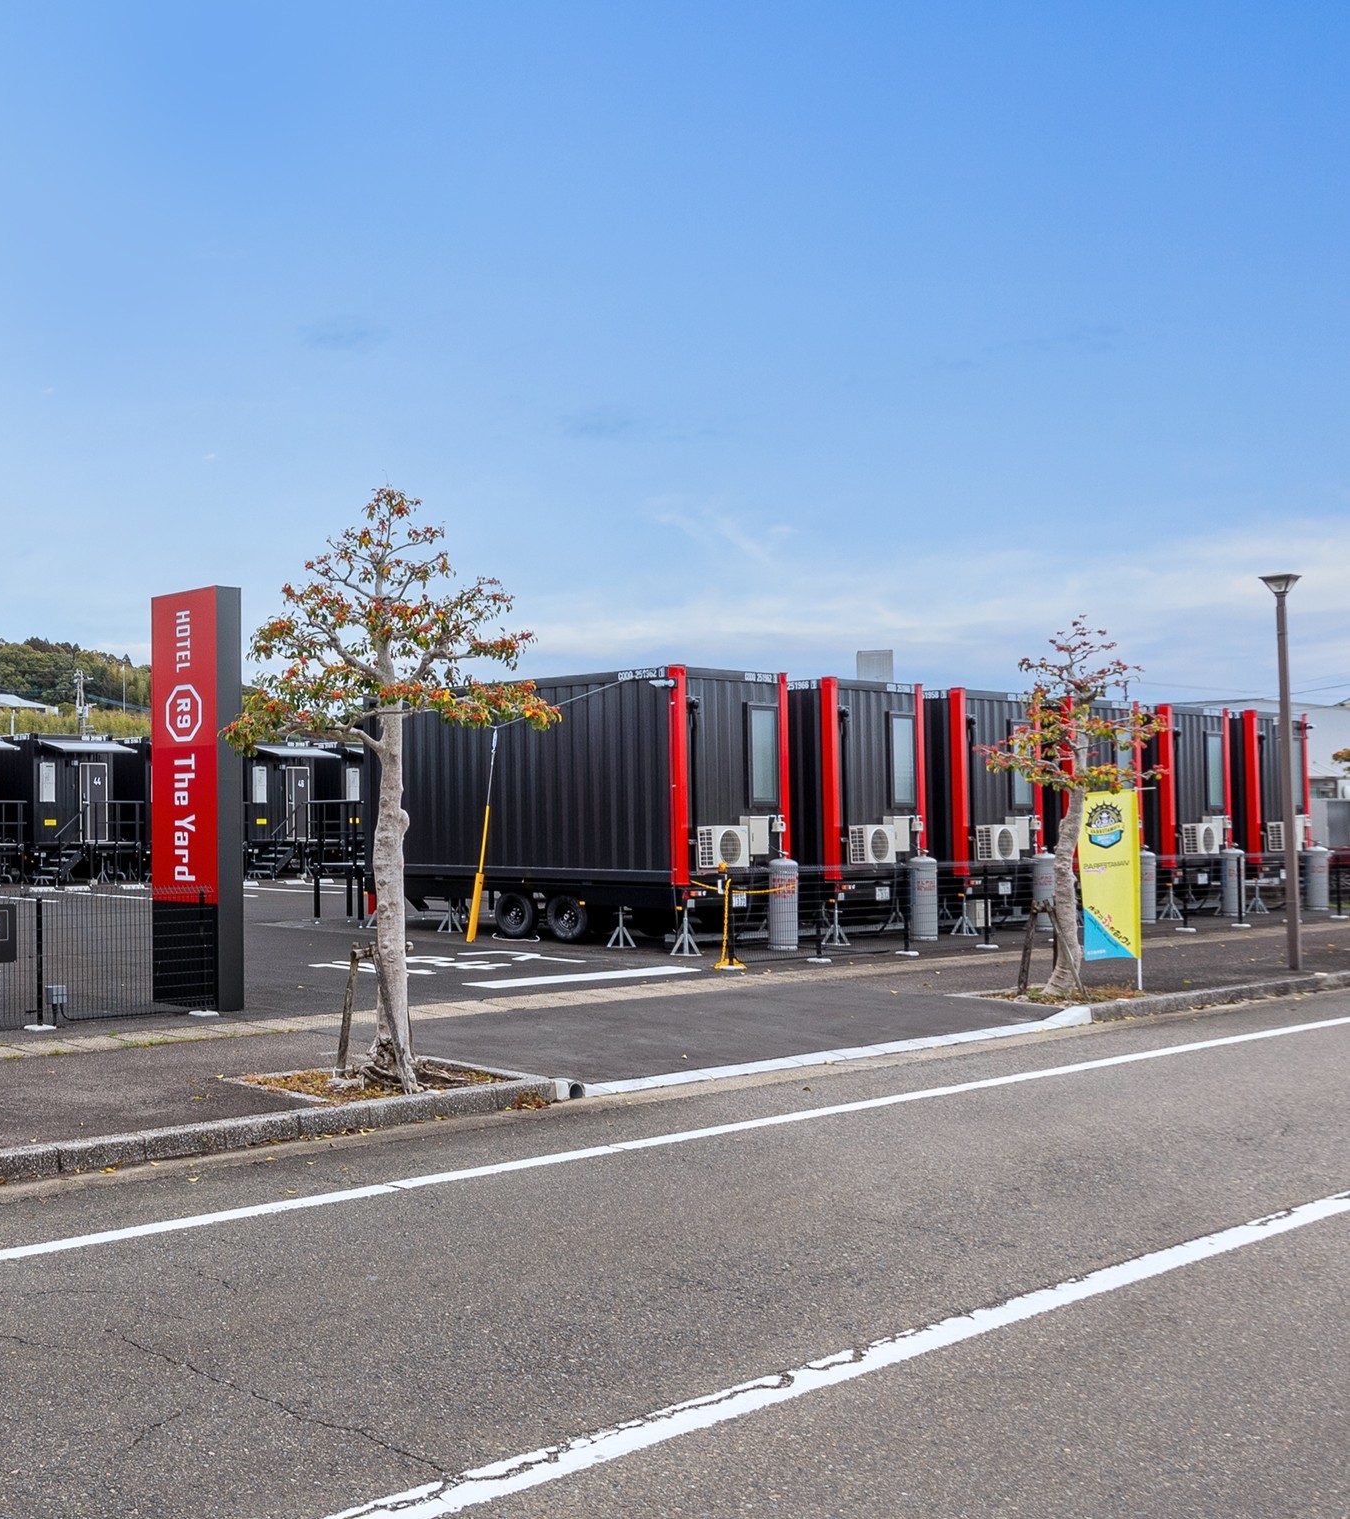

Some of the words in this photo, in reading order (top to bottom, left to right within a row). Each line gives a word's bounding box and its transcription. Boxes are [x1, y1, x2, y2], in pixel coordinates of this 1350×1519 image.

[175, 609, 191, 673] HOTEL
[176, 697, 191, 729] R9
[93, 776, 102, 786] 44
[173, 753, 195, 806] The
[174, 814, 196, 882] Yard
